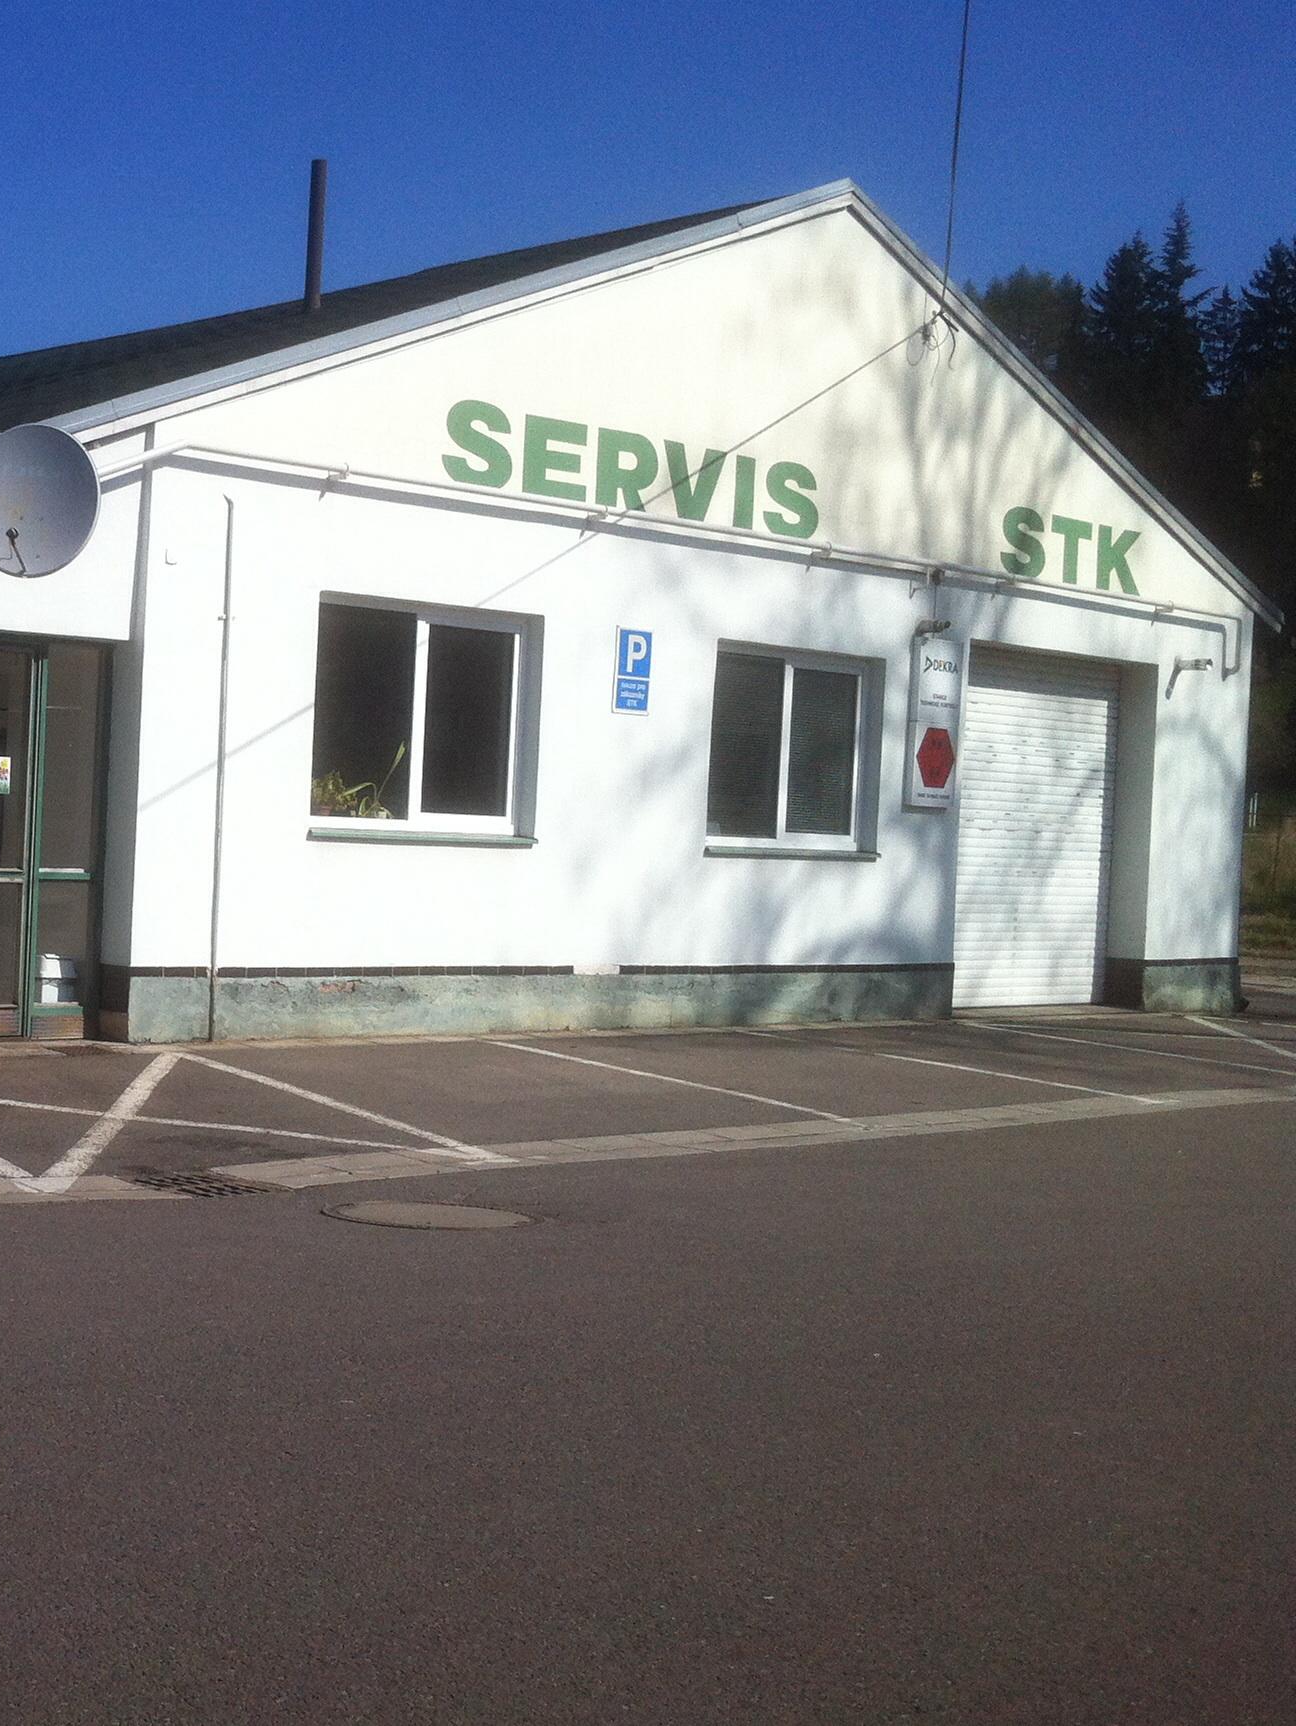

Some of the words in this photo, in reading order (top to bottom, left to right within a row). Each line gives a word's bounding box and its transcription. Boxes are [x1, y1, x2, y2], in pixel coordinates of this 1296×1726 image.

[442, 399, 819, 539] SERVIS
[1000, 506, 1142, 596] STK
[626, 634, 647, 673] P
[933, 659, 959, 674] DEKRA
